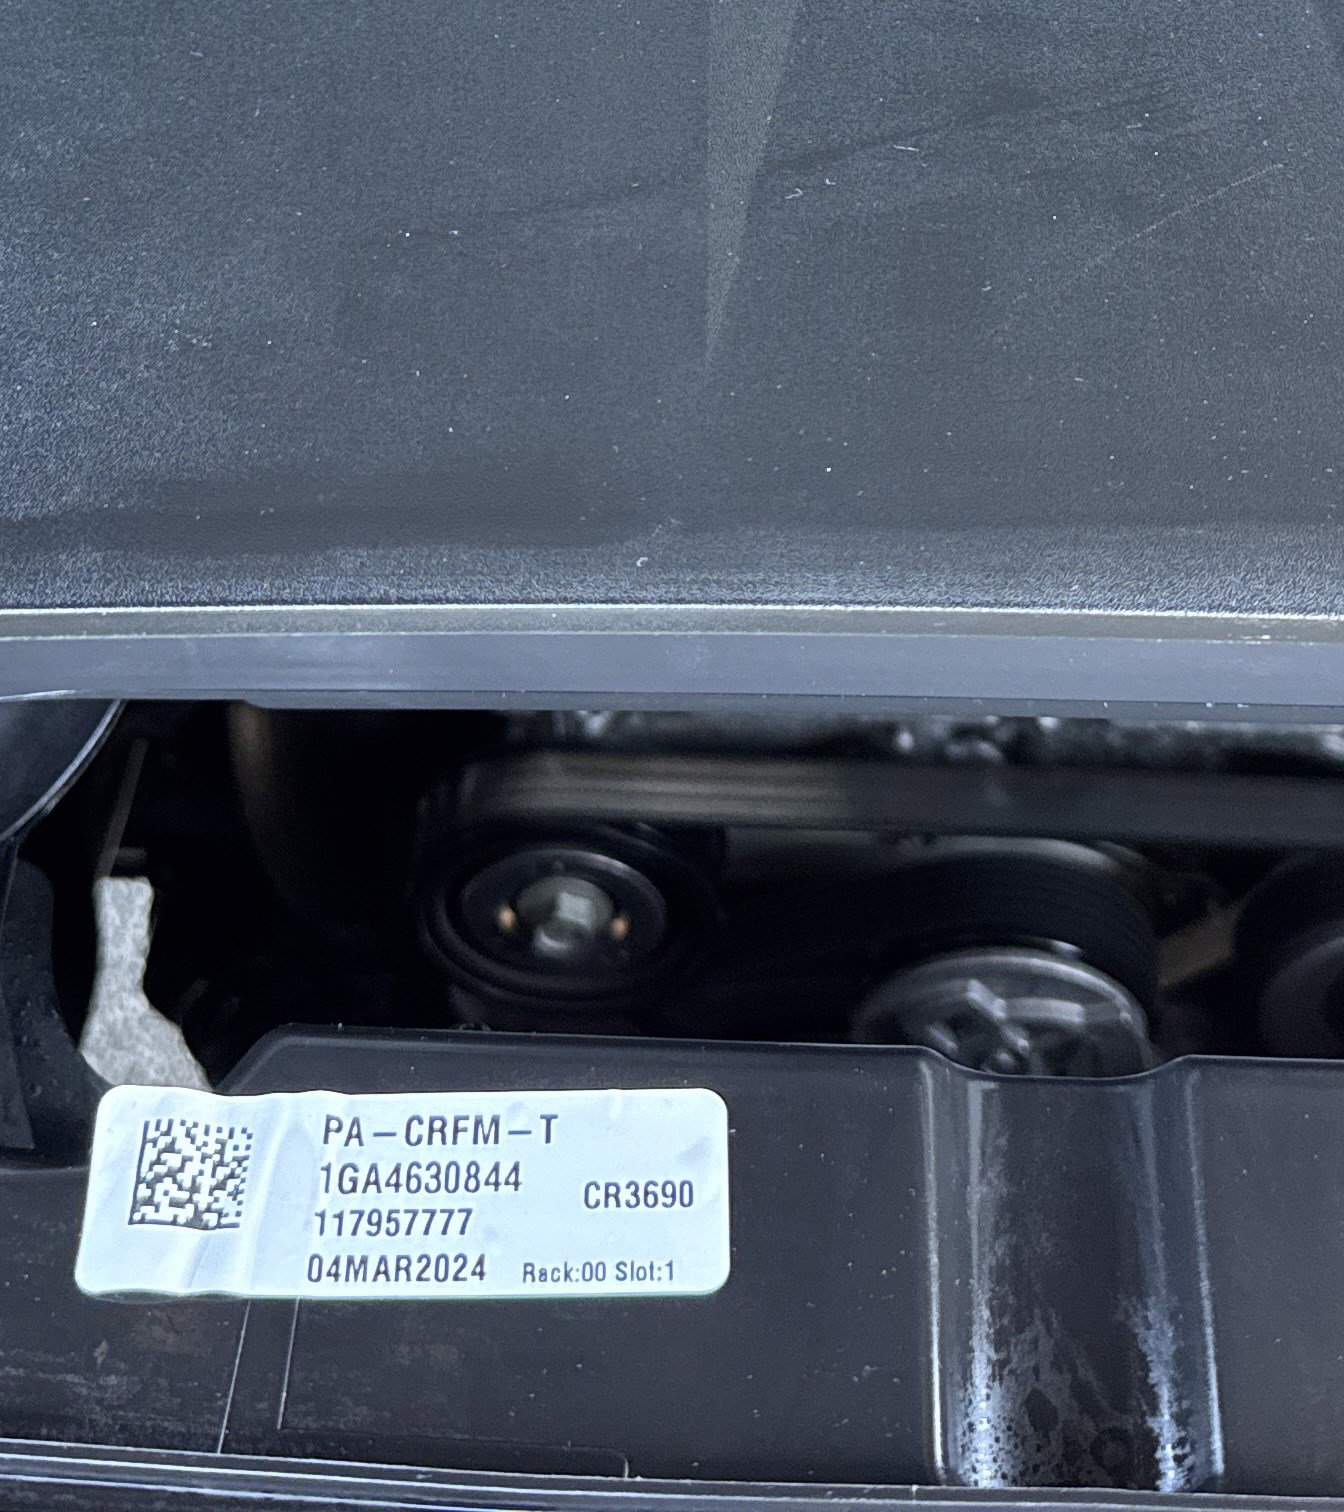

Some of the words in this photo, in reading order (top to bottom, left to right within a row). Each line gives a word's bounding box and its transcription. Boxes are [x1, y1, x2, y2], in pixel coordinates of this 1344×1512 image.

[319, 1160, 524, 1194] 1GA4630844
[583, 1180, 695, 1210] CR3690
[313, 1208, 474, 1238] 117957777
[306, 1253, 488, 1284] 04MAR2024
[522, 1261, 607, 1284] Rack:00
[615, 1260, 675, 1283] Slot:1
